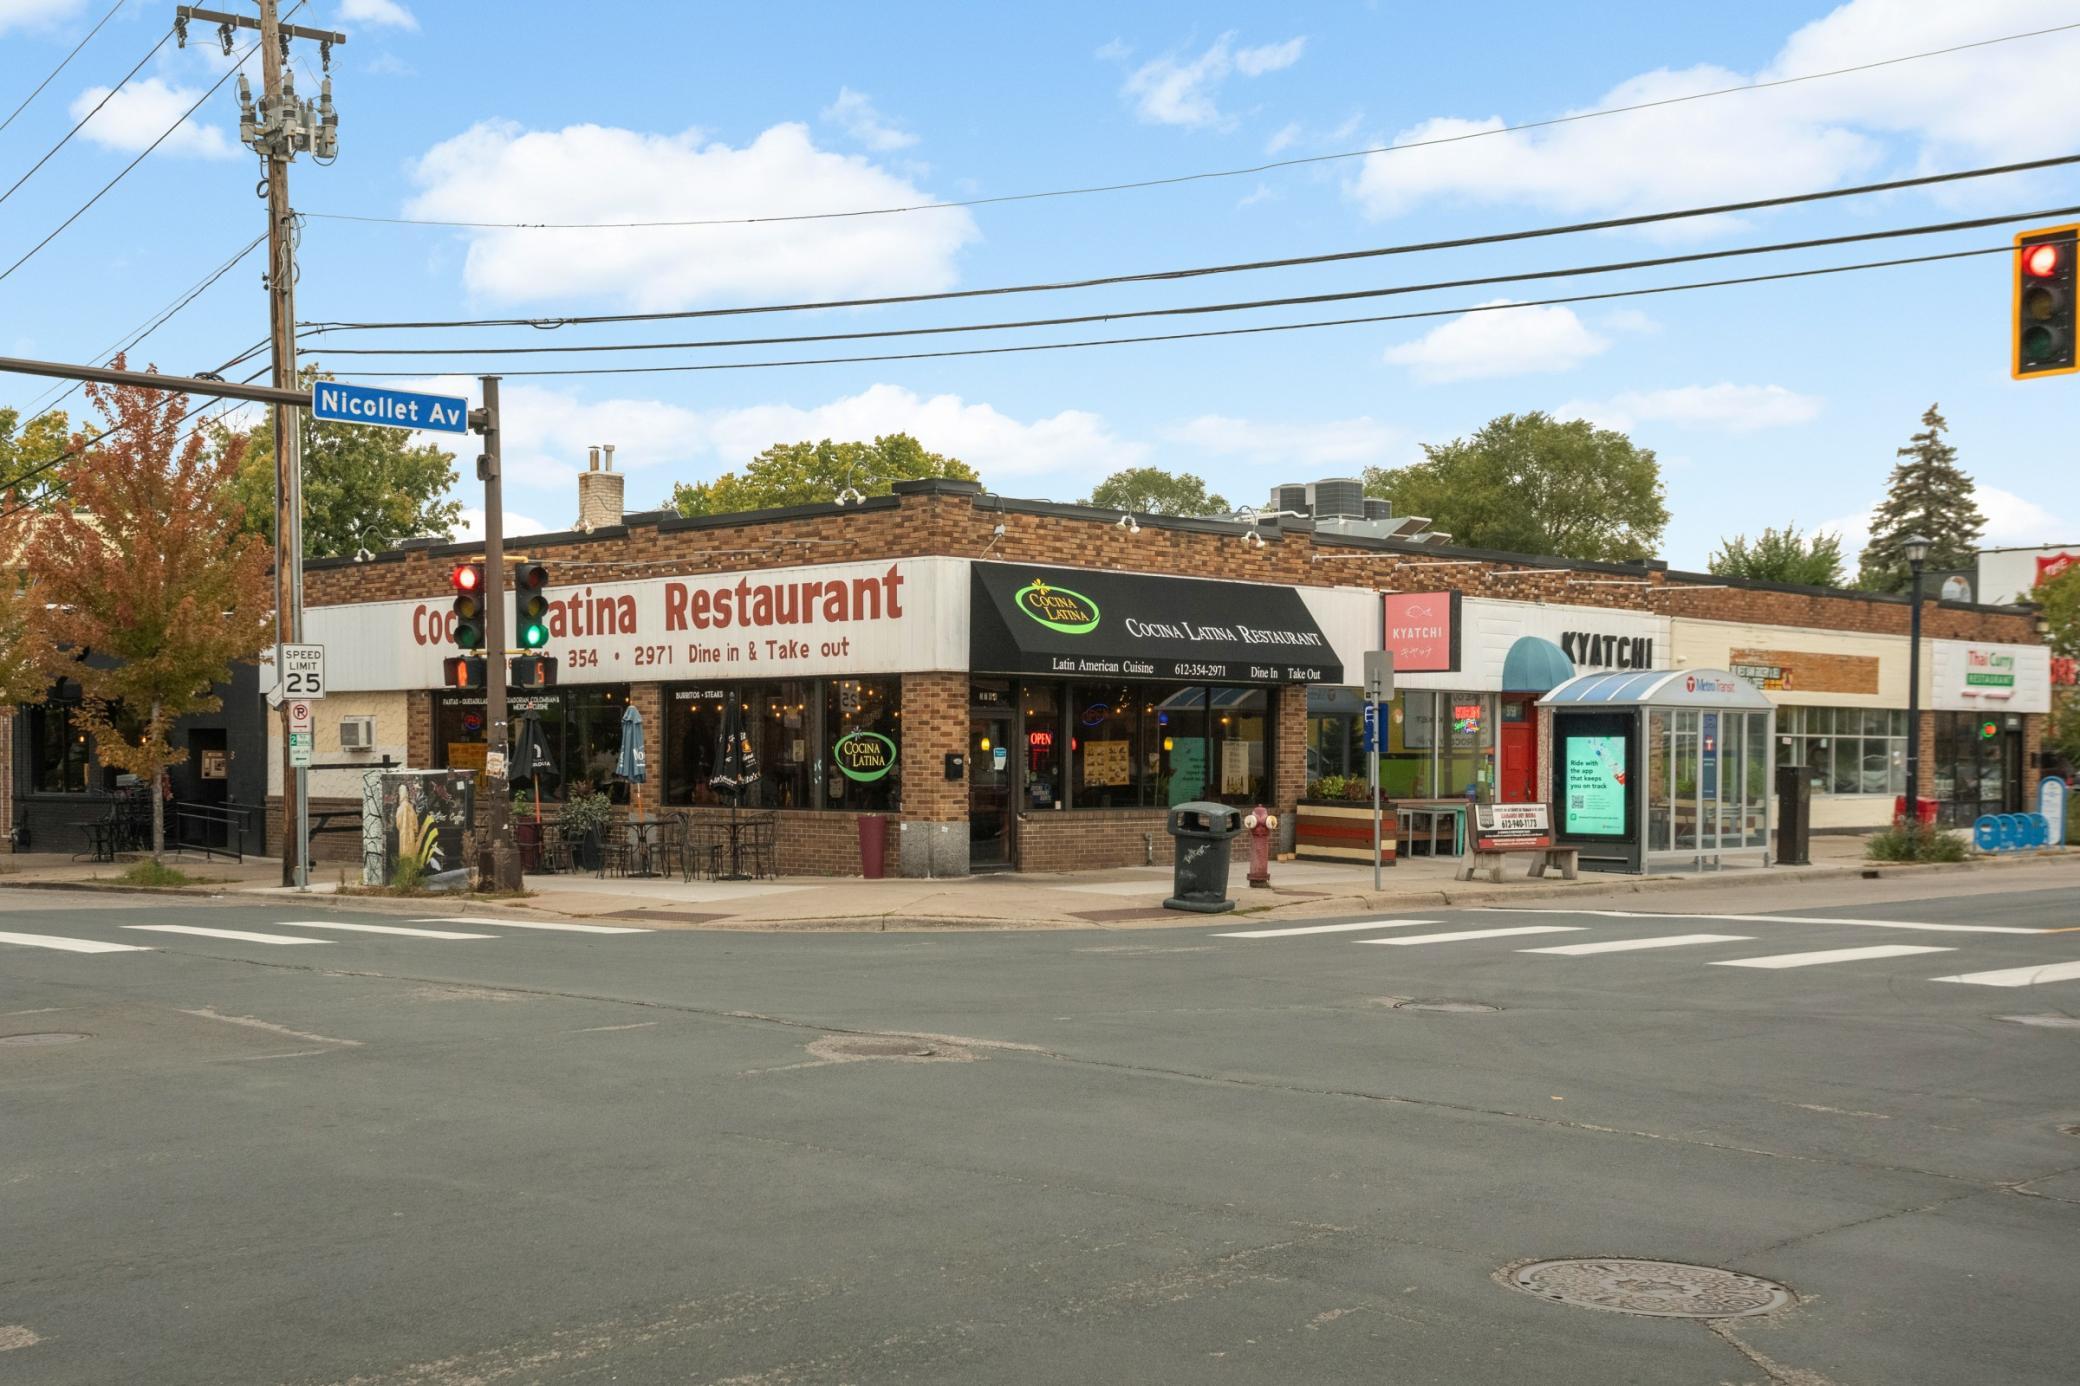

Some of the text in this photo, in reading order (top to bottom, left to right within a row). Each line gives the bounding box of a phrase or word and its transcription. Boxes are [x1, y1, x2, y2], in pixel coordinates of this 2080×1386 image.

[322, 389, 460, 425] Nicollet Av
[547, 586, 637, 638] atina
[665, 562, 904, 631] Restaurant
[1393, 627, 1442, 639] KYATCHI
[286, 650, 321, 660] SPEED
[568, 649, 598, 668] 354
[635, 645, 673, 666] 2971
[688, 644, 721, 663] Dine
[727, 643, 739, 661] in
[748, 641, 758, 661] &
[765, 639, 809, 660] Take
[821, 636, 850, 657] out
[1562, 632, 1653, 669] KYATCHI
[1968, 650, 1988, 666] Thai
[289, 662, 318, 671] LIMIT
[1052, 657, 1321, 680] Latin American Cuisine 612-354-2971 Dine In Take Out
[286, 673, 321, 693] 25
[675, 690, 723, 699] BURRITOS STEAKS
[1030, 732, 1052, 745] OPEN
[1584, 775, 1602, 783] keeps
